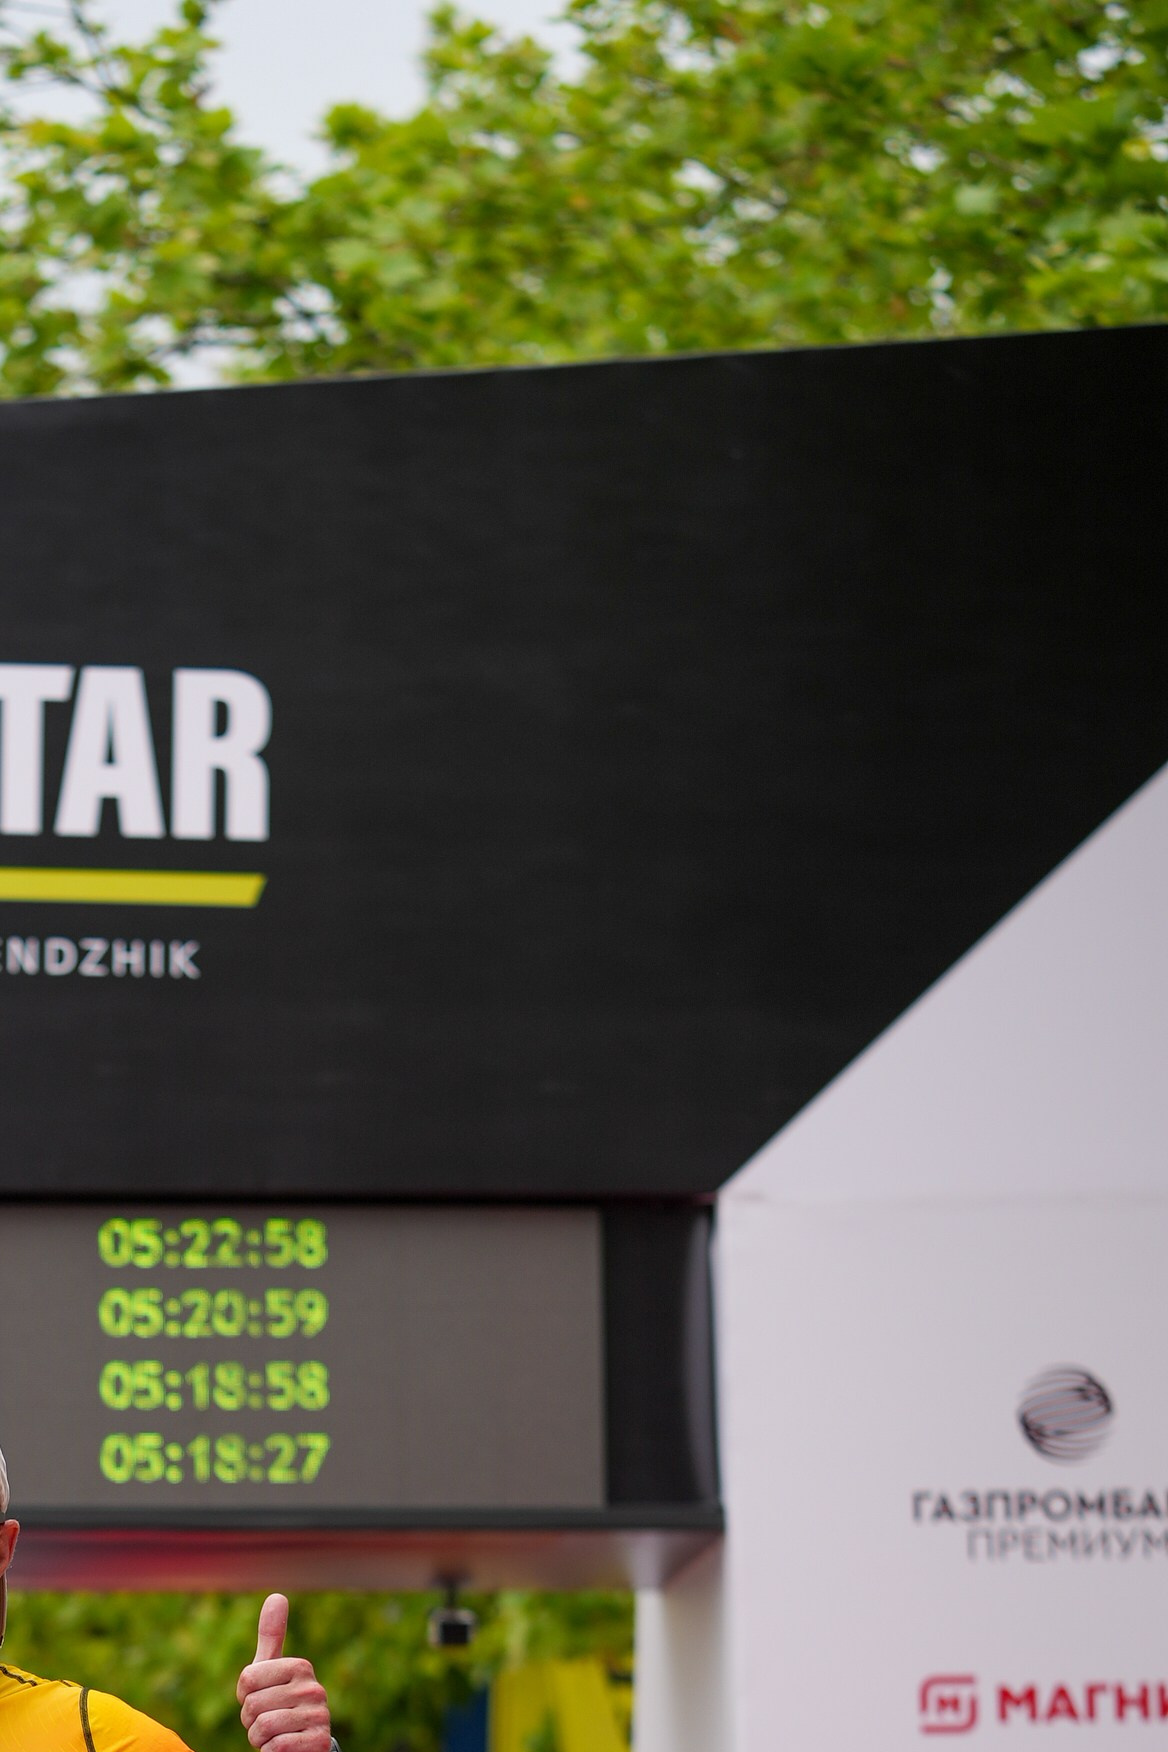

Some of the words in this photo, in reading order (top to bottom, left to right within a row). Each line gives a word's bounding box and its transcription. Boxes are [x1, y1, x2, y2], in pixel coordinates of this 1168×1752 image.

[97, 1217, 329, 1269] 05:22:58
[97, 1286, 329, 1338] 05:20:59
[97, 1359, 330, 1411] 05:18:58
[98, 1431, 331, 1484] 05:18:27
[912, 1488, 1168, 1523] ГАЗПРОМБА
[996, 1683, 1168, 1723] МАГН
